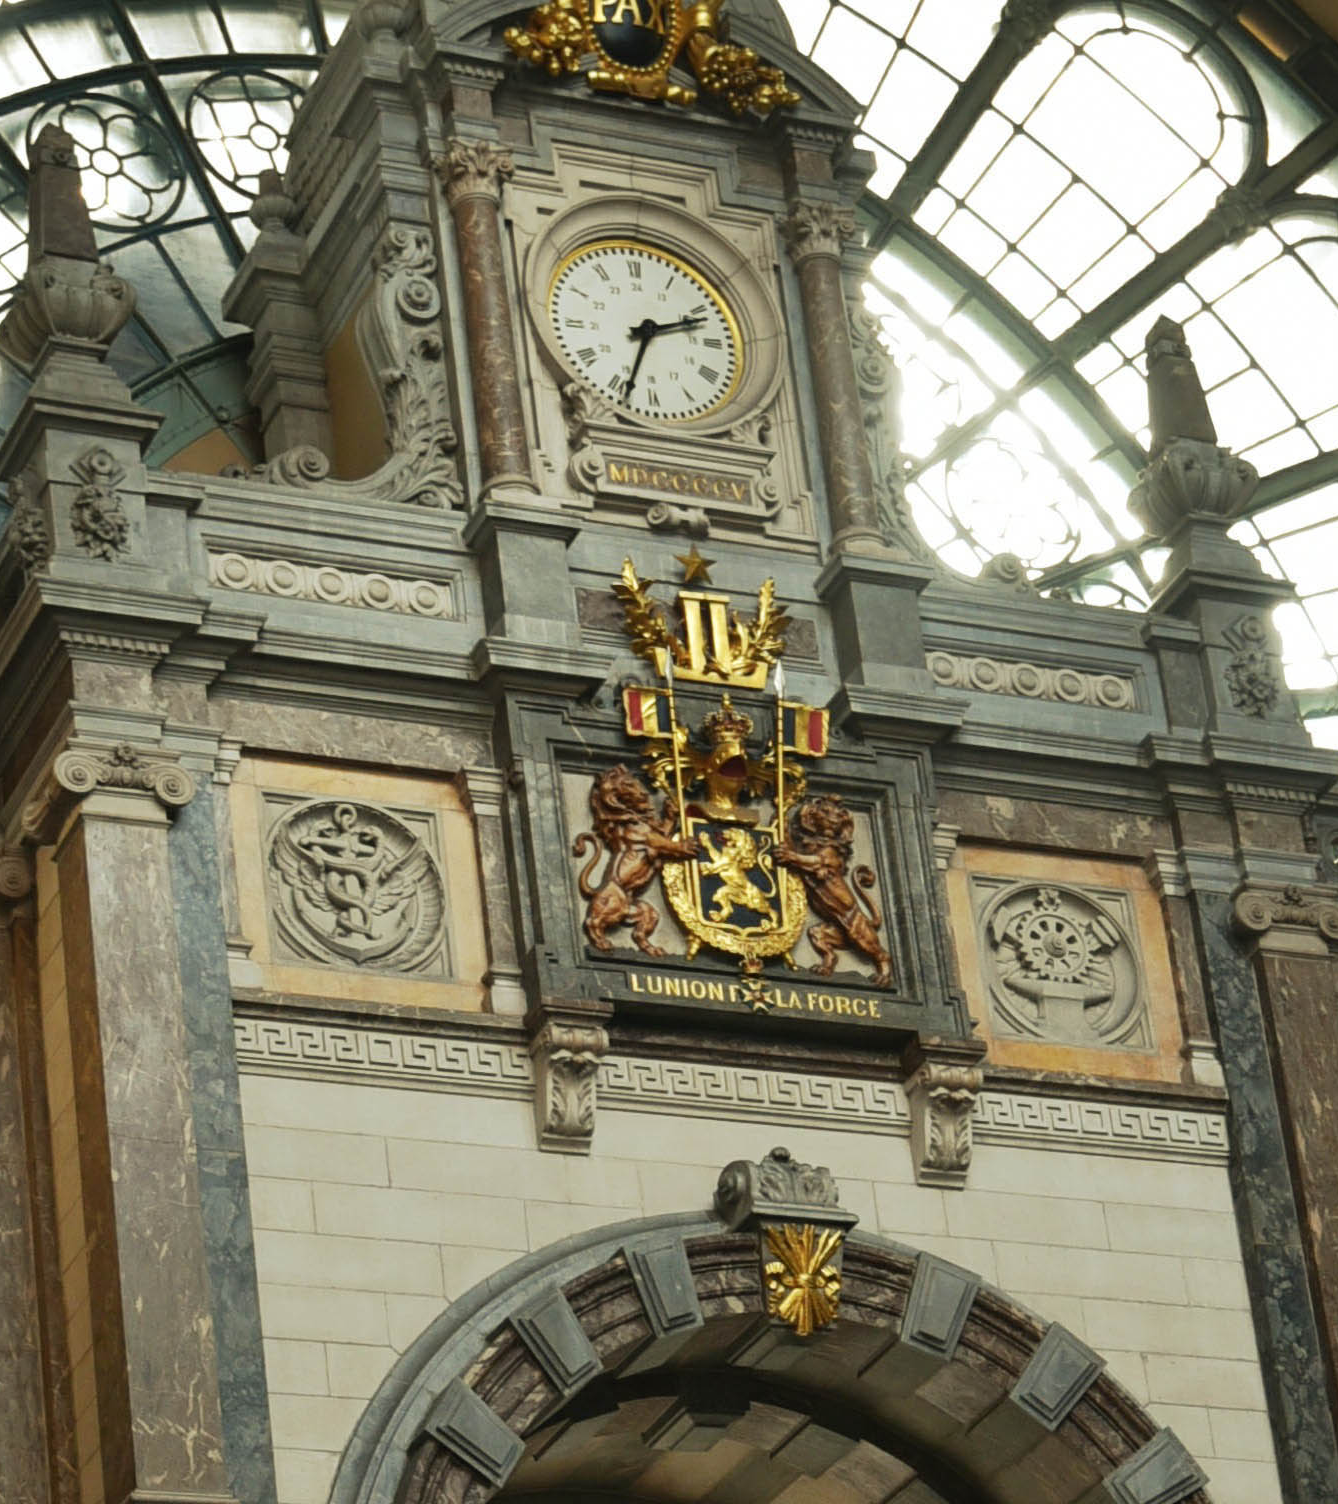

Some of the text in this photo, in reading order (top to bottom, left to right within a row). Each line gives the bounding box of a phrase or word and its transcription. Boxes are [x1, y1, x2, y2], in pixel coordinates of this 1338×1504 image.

[610, 462, 745, 501] MDCCCCV
[775, 988, 802, 1009] LA
[807, 992, 880, 1018] FORCE
